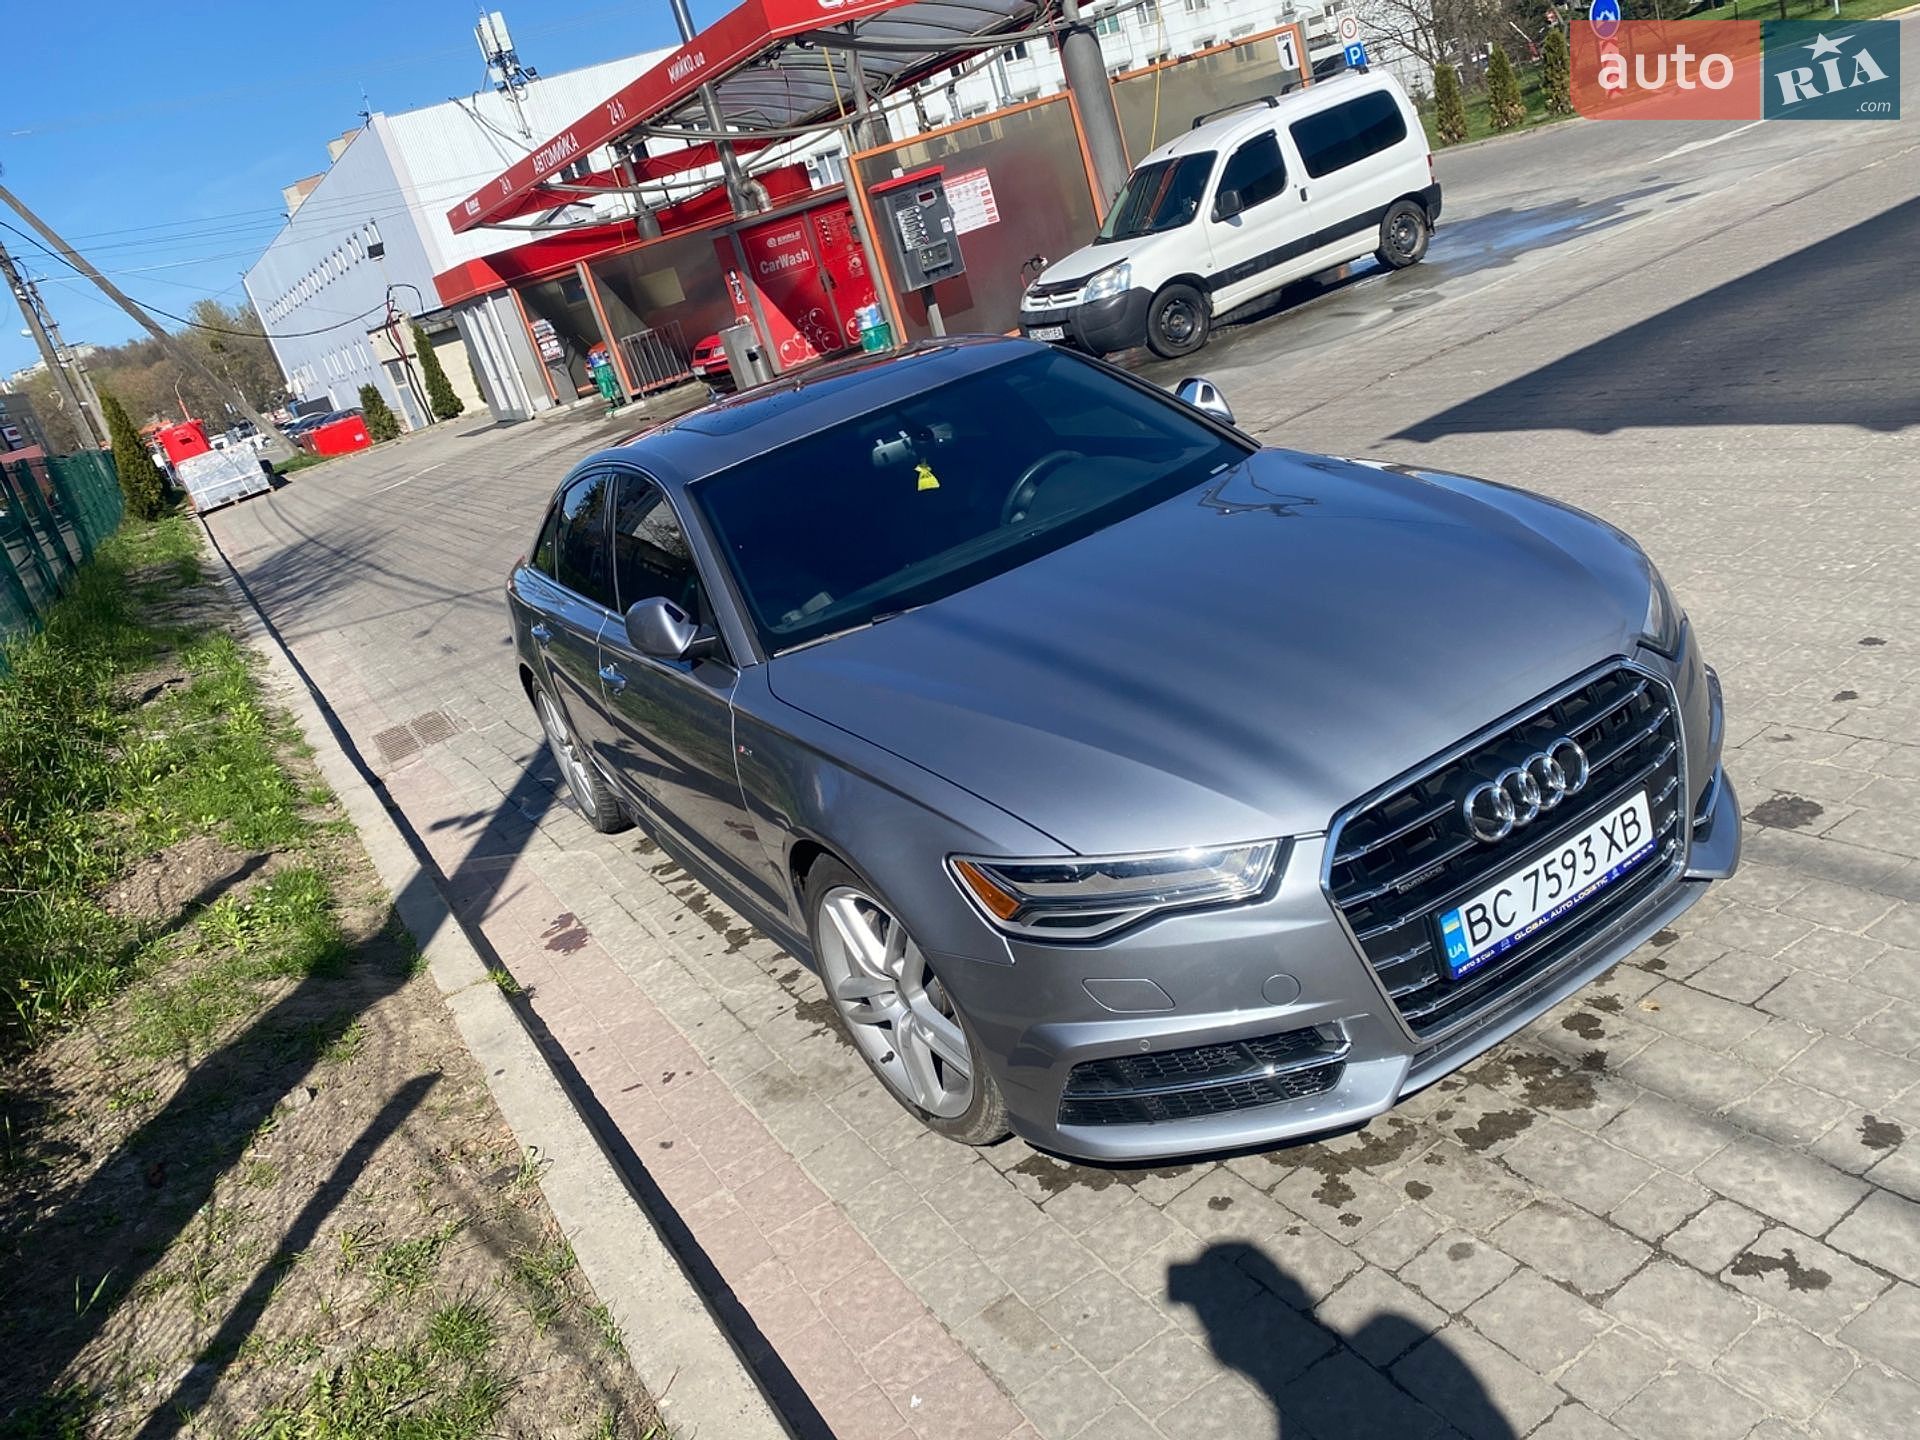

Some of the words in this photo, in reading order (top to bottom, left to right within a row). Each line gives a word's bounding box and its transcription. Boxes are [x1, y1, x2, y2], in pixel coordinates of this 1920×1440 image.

[1282, 41, 1294, 66] 1
[1349, 46, 1361, 65] P
[606, 101, 620, 125] 24
[531, 132, 580, 175] АВТОМИЙКА
[760, 248, 810, 274] CarWash
[1464, 889, 1517, 947] BC
[1522, 834, 1597, 912] 7593
[1599, 806, 1642, 862] XB
[1514, 914, 1550, 940] GLOBAL
[1550, 899, 1574, 918] AUTO
[1573, 876, 1609, 904] LOGISTIC
[1448, 942, 1466, 959] UA
